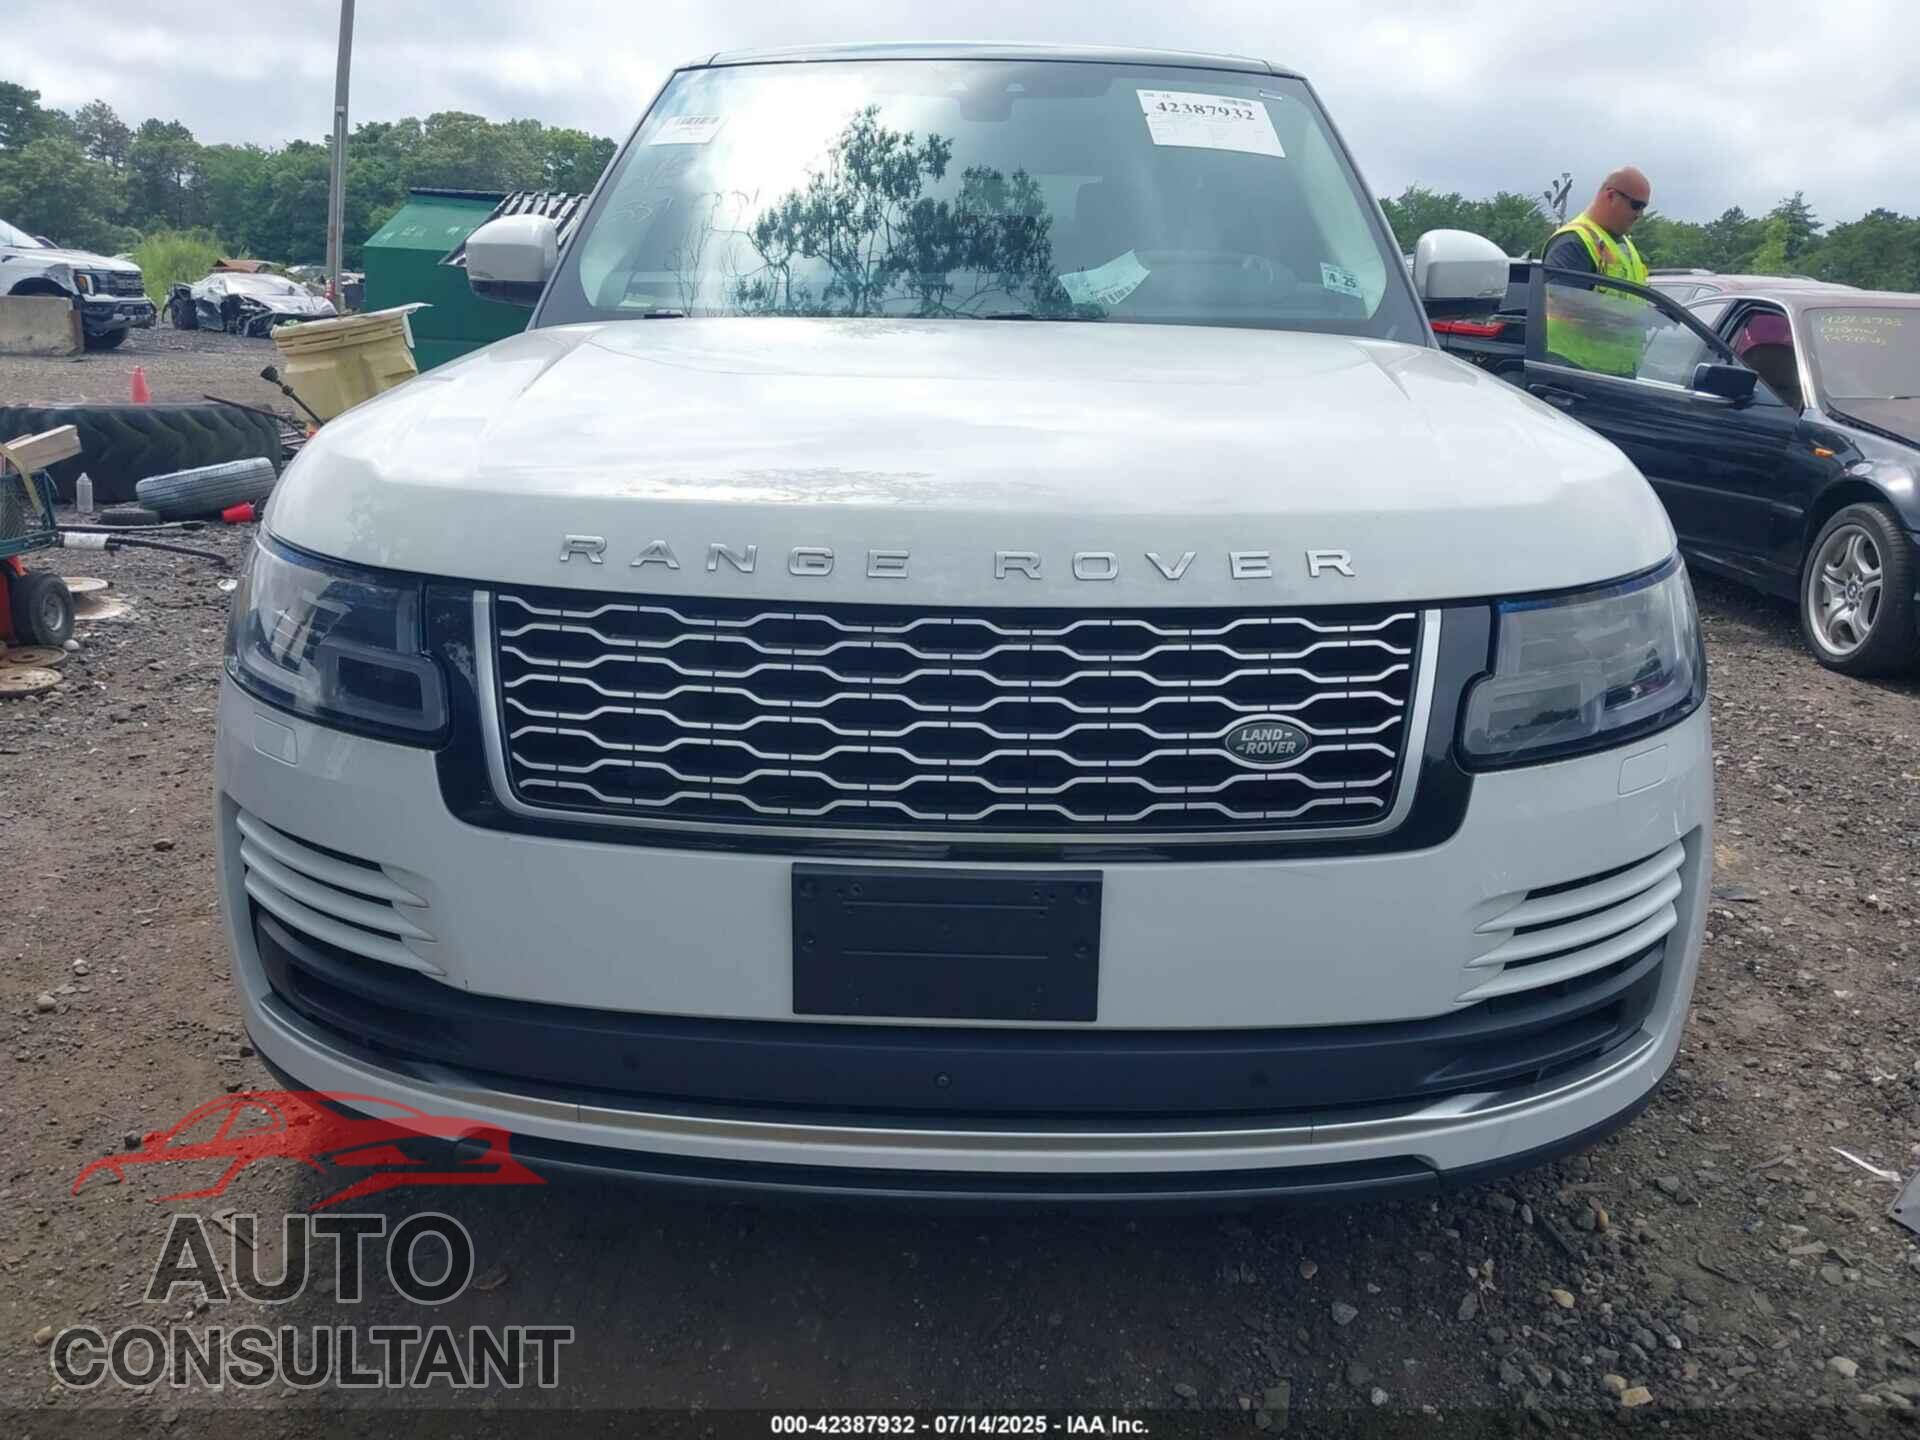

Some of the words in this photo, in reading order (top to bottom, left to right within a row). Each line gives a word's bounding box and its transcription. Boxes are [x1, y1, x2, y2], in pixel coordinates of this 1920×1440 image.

[1155, 102, 1256, 121] 42387932
[559, 534, 912, 579] RANGE
[993, 550, 1356, 582] ROVER
[1240, 728, 1284, 741] LAND
[1244, 741, 1297, 754] ROVER
